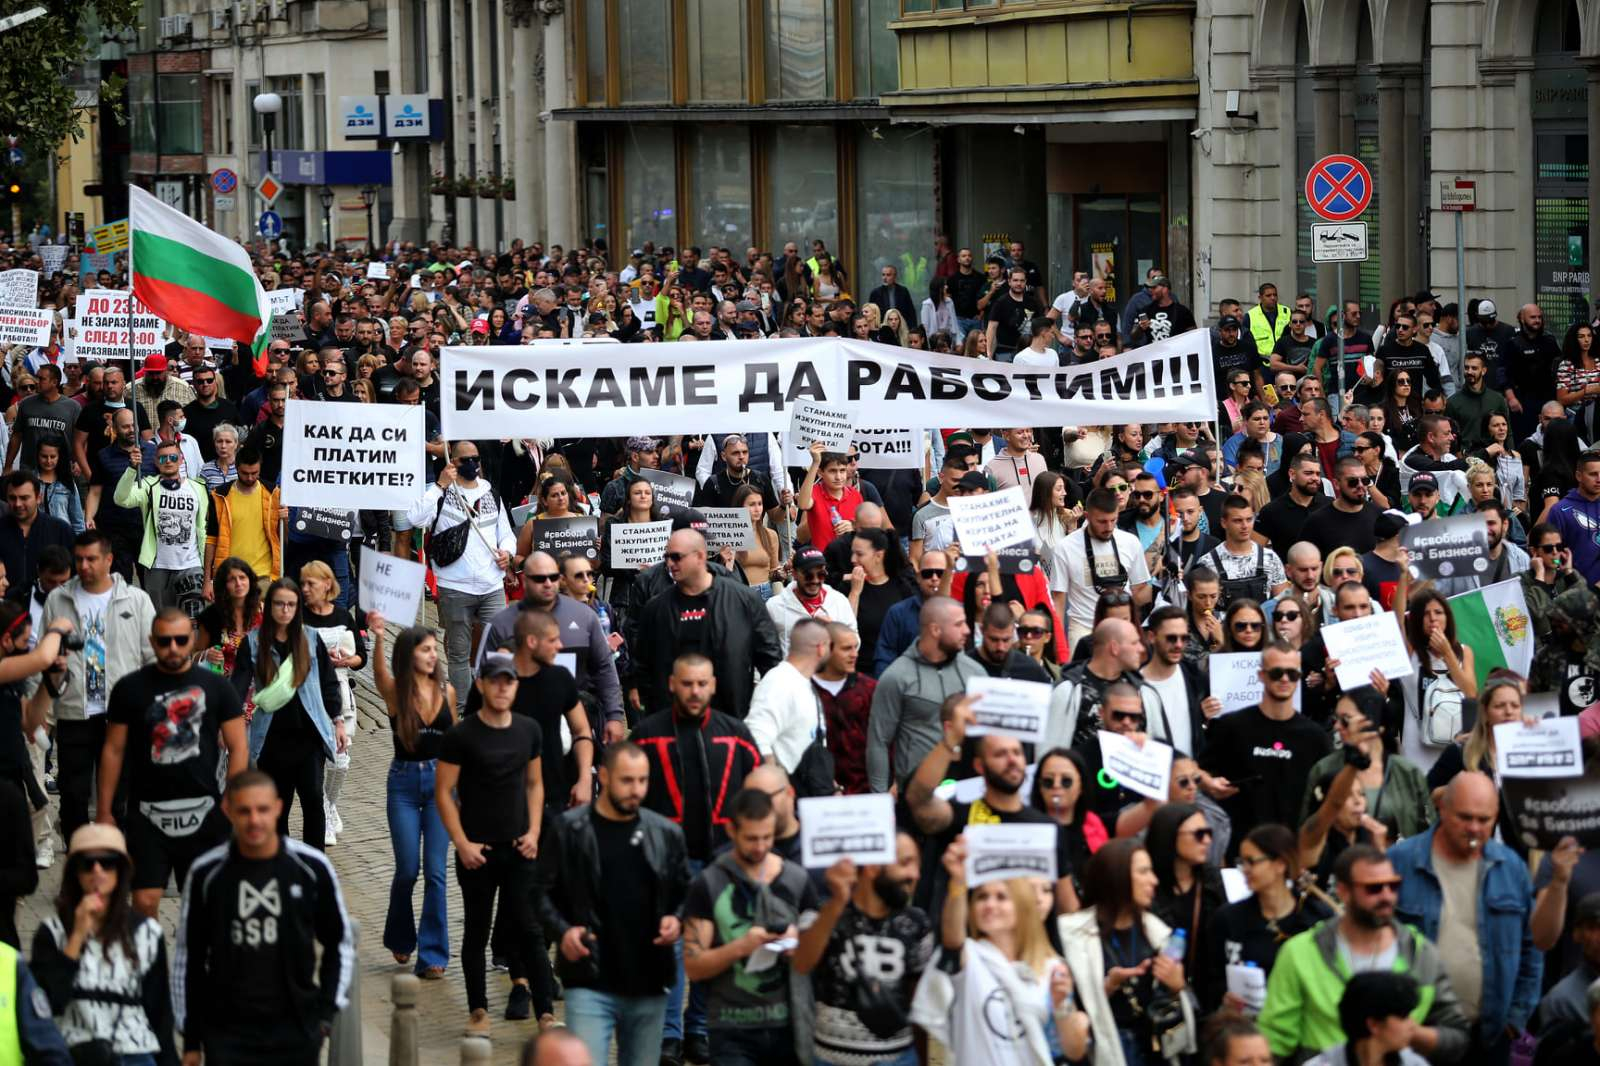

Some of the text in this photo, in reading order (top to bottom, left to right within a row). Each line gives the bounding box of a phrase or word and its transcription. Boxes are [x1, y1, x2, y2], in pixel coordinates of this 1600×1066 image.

[347, 119, 374, 127] ДЗИ
[395, 119, 423, 127] ДЗИ
[1553, 271, 1568, 282] BNP
[87, 298, 110, 315] ДО
[18, 318, 49, 328] ИЗБОР
[81, 316, 94, 327] НЕ
[5, 326, 39, 334] УСЛОВИЕ
[3, 334, 38, 343] РАБОТА!!!
[84, 330, 118, 346] СЛЕД
[455, 353, 1202, 412] ИСКАМЕ ДА РАБОТИМ!!!
[804, 406, 848, 420] СТАНАХМЕ
[795, 414, 852, 430] ИЗКУПИТЕЛНА
[304, 424, 407, 443] КАК ДА СИ
[800, 425, 832, 438] ЖЕРТВА
[850, 440, 911, 454] БОТА!!!
[313, 448, 397, 464] ПЛАТИМ
[293, 469, 415, 487] СМЕТКИТЕ!?
[159, 494, 194, 511] DOGS
[657, 493, 689, 508] Бизнеса
[302, 510, 351, 528] За Бизнеса
[1004, 519, 1018, 527] НА
[622, 526, 667, 535] СТАНАХМЕ
[539, 540, 593, 549] За Бизнеса
[615, 535, 669, 545] ИЗКУПИТЕЛН
[1408, 545, 1482, 561] За Бизнеса
[376, 562, 393, 576] НЕ
[1232, 659, 1264, 669] ИСКА
[1226, 691, 1264, 701] РАБОТ
[161, 813, 199, 830] FILA
